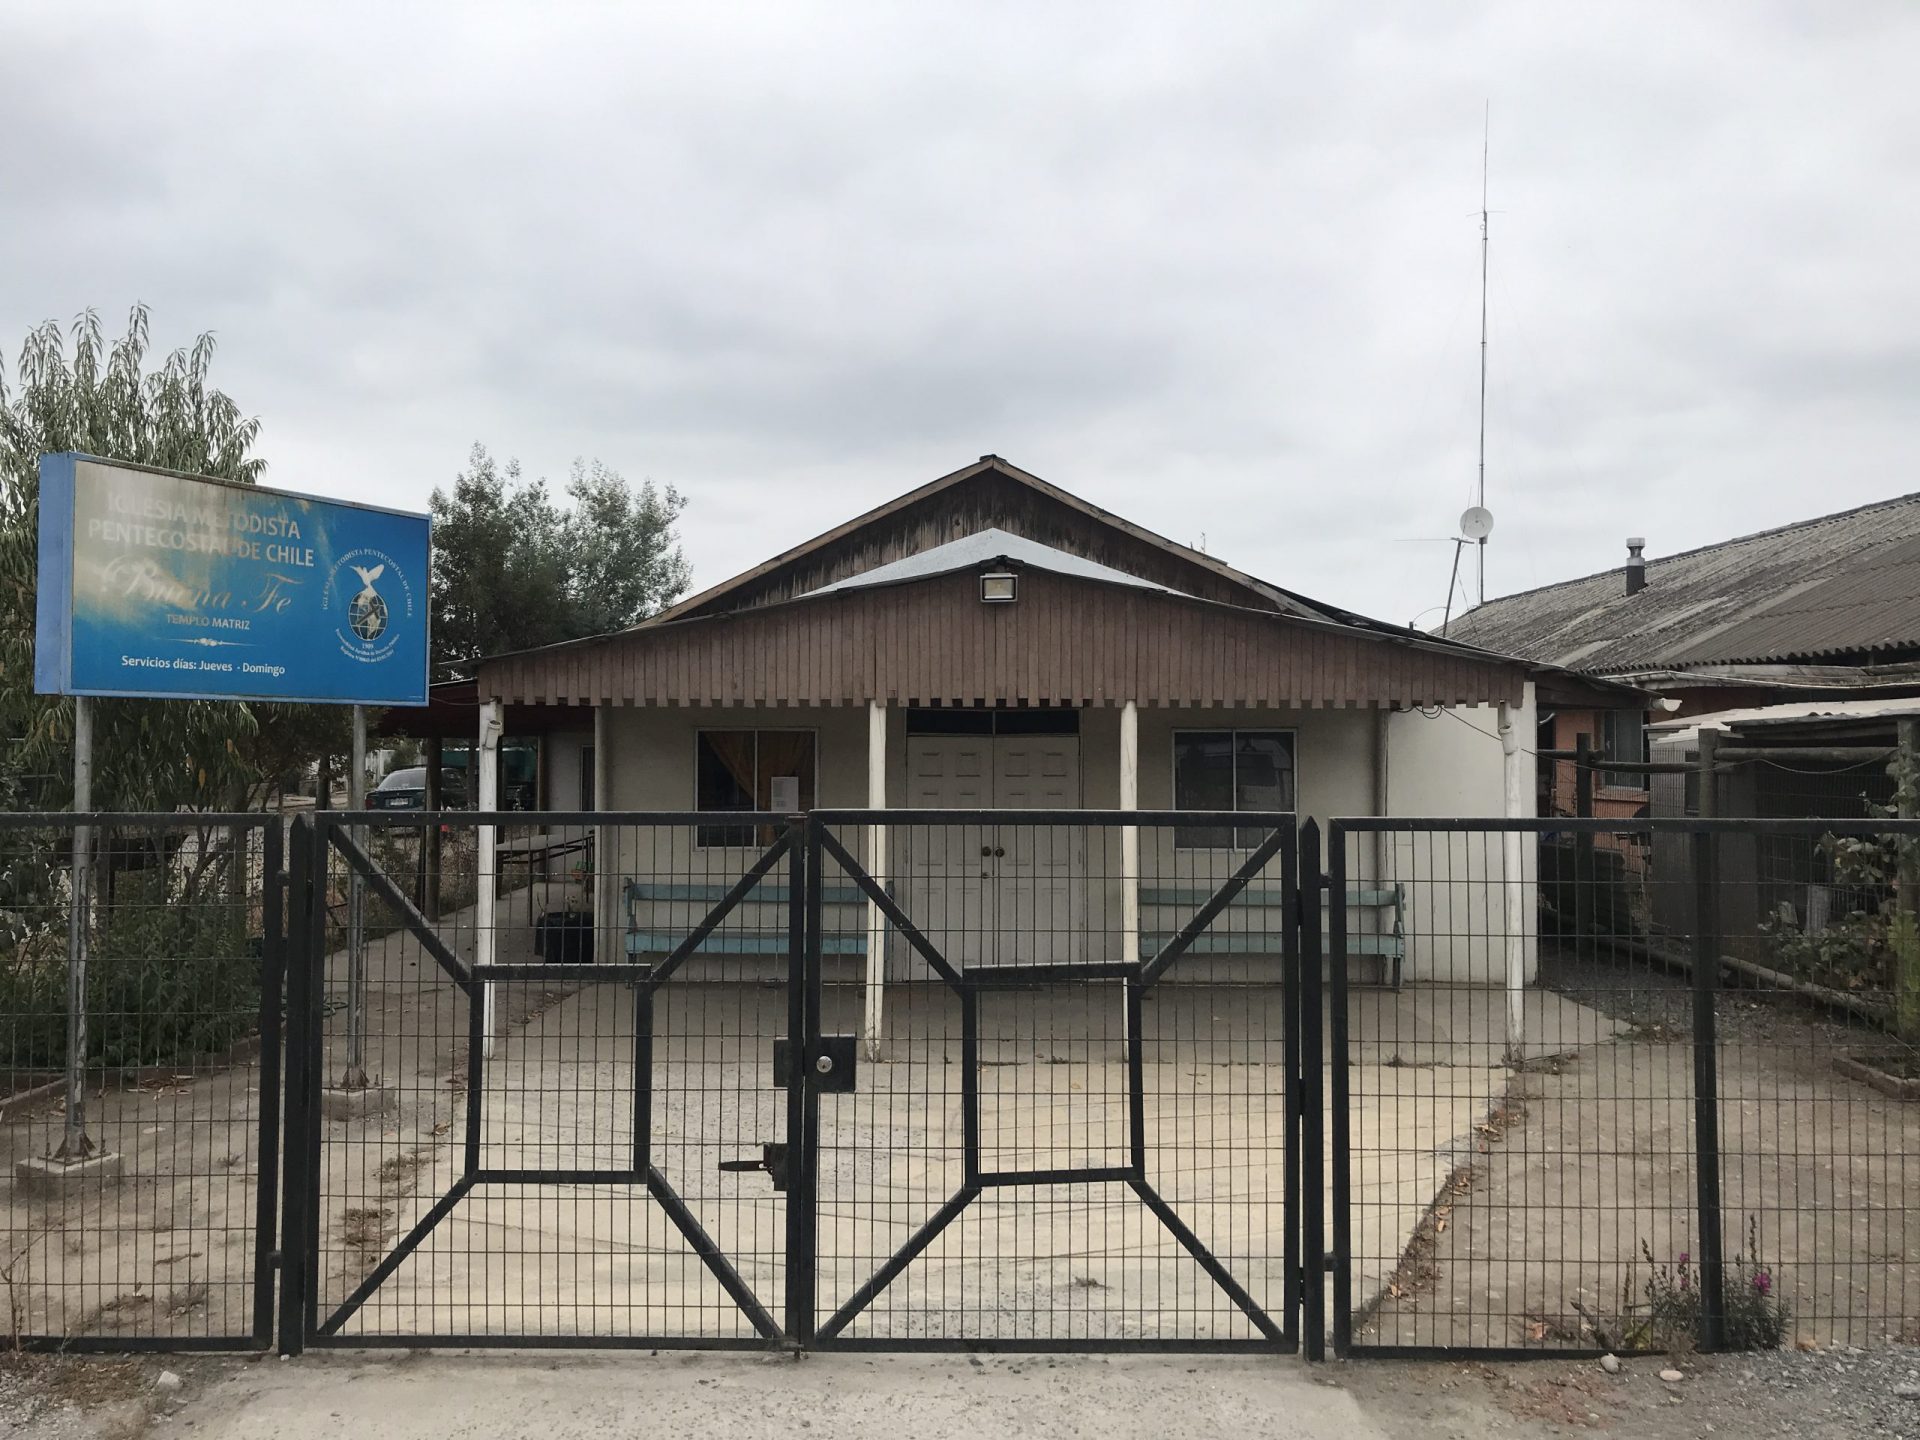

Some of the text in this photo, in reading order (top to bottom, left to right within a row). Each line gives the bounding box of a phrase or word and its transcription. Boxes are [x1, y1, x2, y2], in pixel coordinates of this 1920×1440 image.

[88, 519, 314, 567] PENTECOSTAL DE CHILE
[166, 613, 250, 630] TEMPLO MATRIZ
[121, 655, 170, 669] Servicios
[172, 657, 197, 670] días:
[199, 660, 232, 672] Jueves
[243, 663, 285, 677] Domingo
